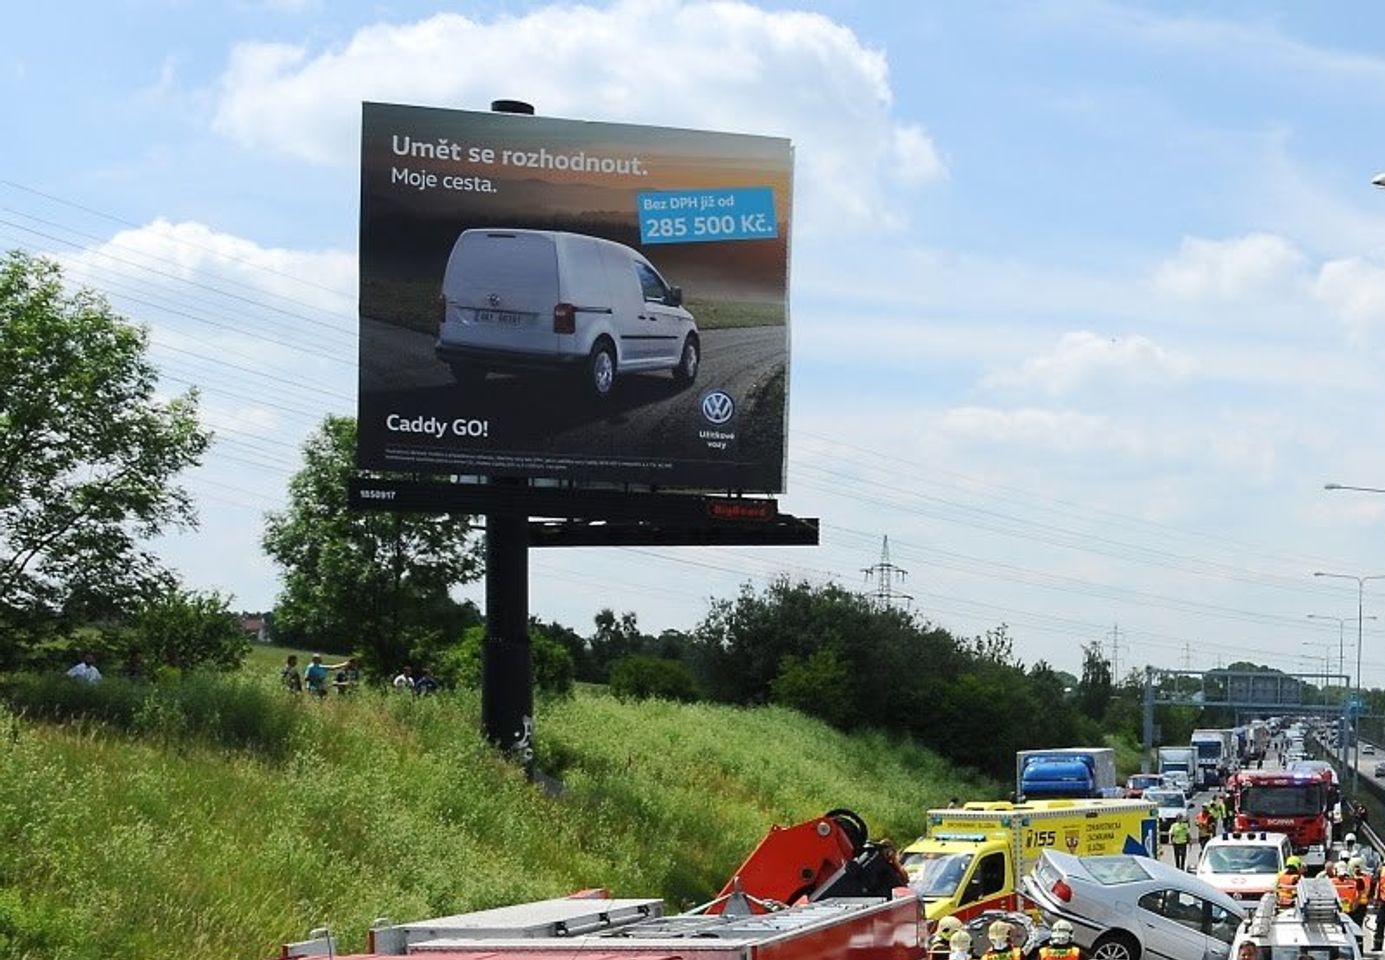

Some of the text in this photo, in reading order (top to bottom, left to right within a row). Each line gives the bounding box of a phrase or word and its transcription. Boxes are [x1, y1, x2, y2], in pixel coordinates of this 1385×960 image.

[392, 134, 649, 176] Umět se rozhodnout.
[391, 167, 498, 193] Moje cesta.
[643, 194, 735, 211] Bez DPH již od
[646, 212, 773, 237] 285 500 Kč.
[386, 414, 489, 438] Caddy GO!
[1034, 830, 1056, 847] 155
